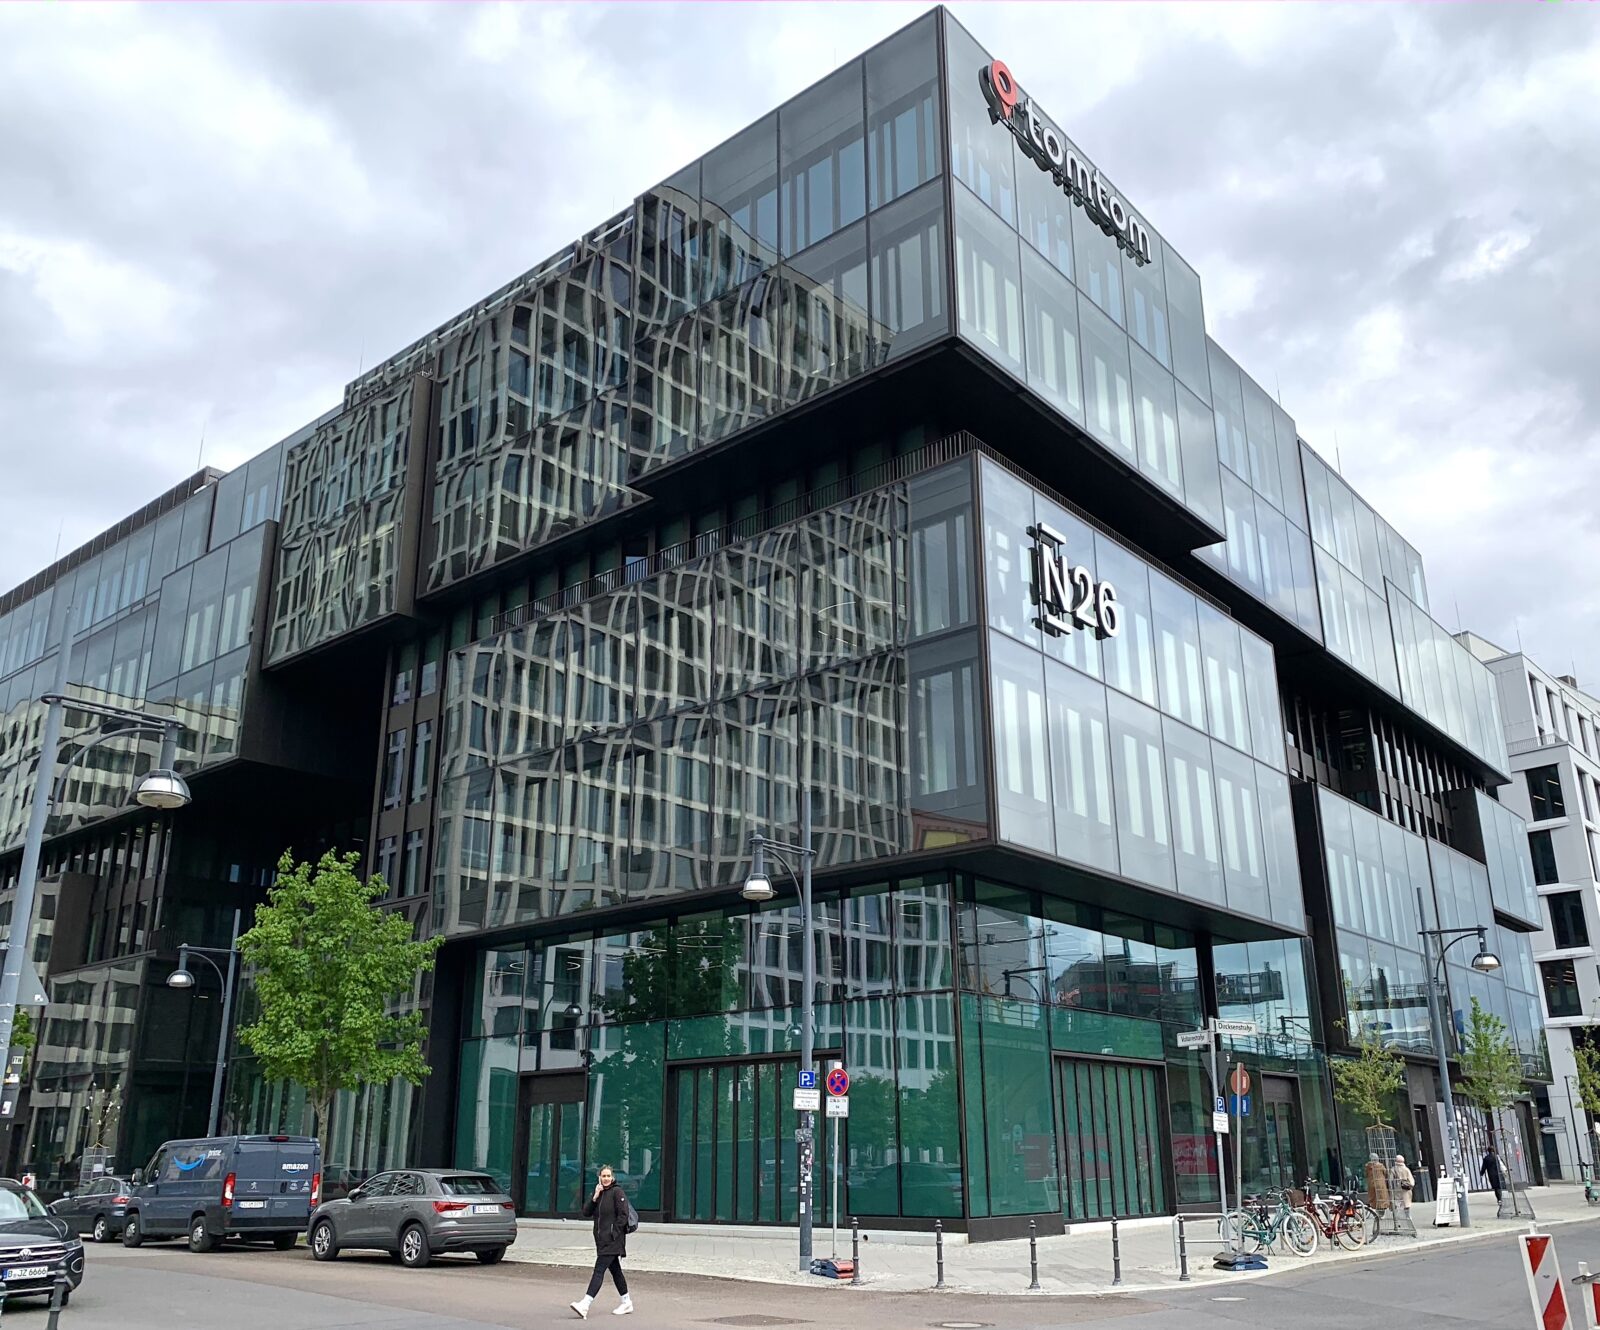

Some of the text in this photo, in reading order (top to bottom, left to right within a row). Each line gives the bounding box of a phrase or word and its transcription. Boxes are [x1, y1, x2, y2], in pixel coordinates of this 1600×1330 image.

[1024, 96, 1152, 264] tomtom
[1038, 522, 1121, 638] N26
[801, 1072, 810, 1086] P
[28, 1267, 47, 1276] 6666
